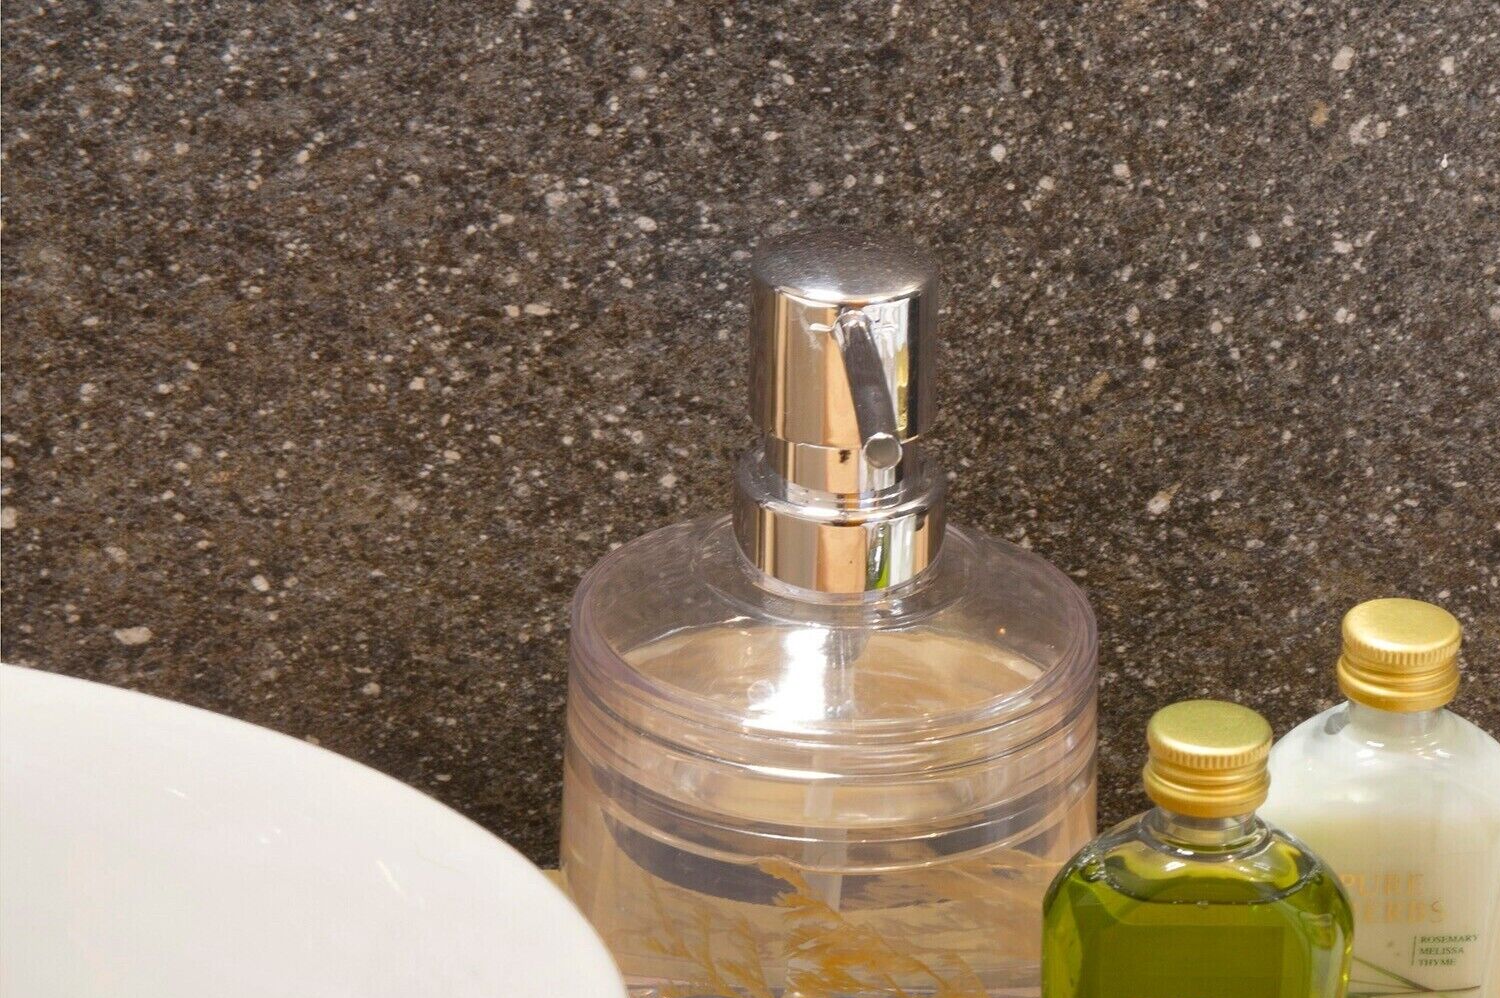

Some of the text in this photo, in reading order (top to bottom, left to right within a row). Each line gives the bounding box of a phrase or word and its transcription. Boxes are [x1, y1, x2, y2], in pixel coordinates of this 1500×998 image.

[1353, 902, 1447, 924] ERBS
[1419, 934, 1478, 943] ROSEMARY
[1419, 947, 1465, 956] MELISSA
[1418, 959, 1456, 967] THYME
